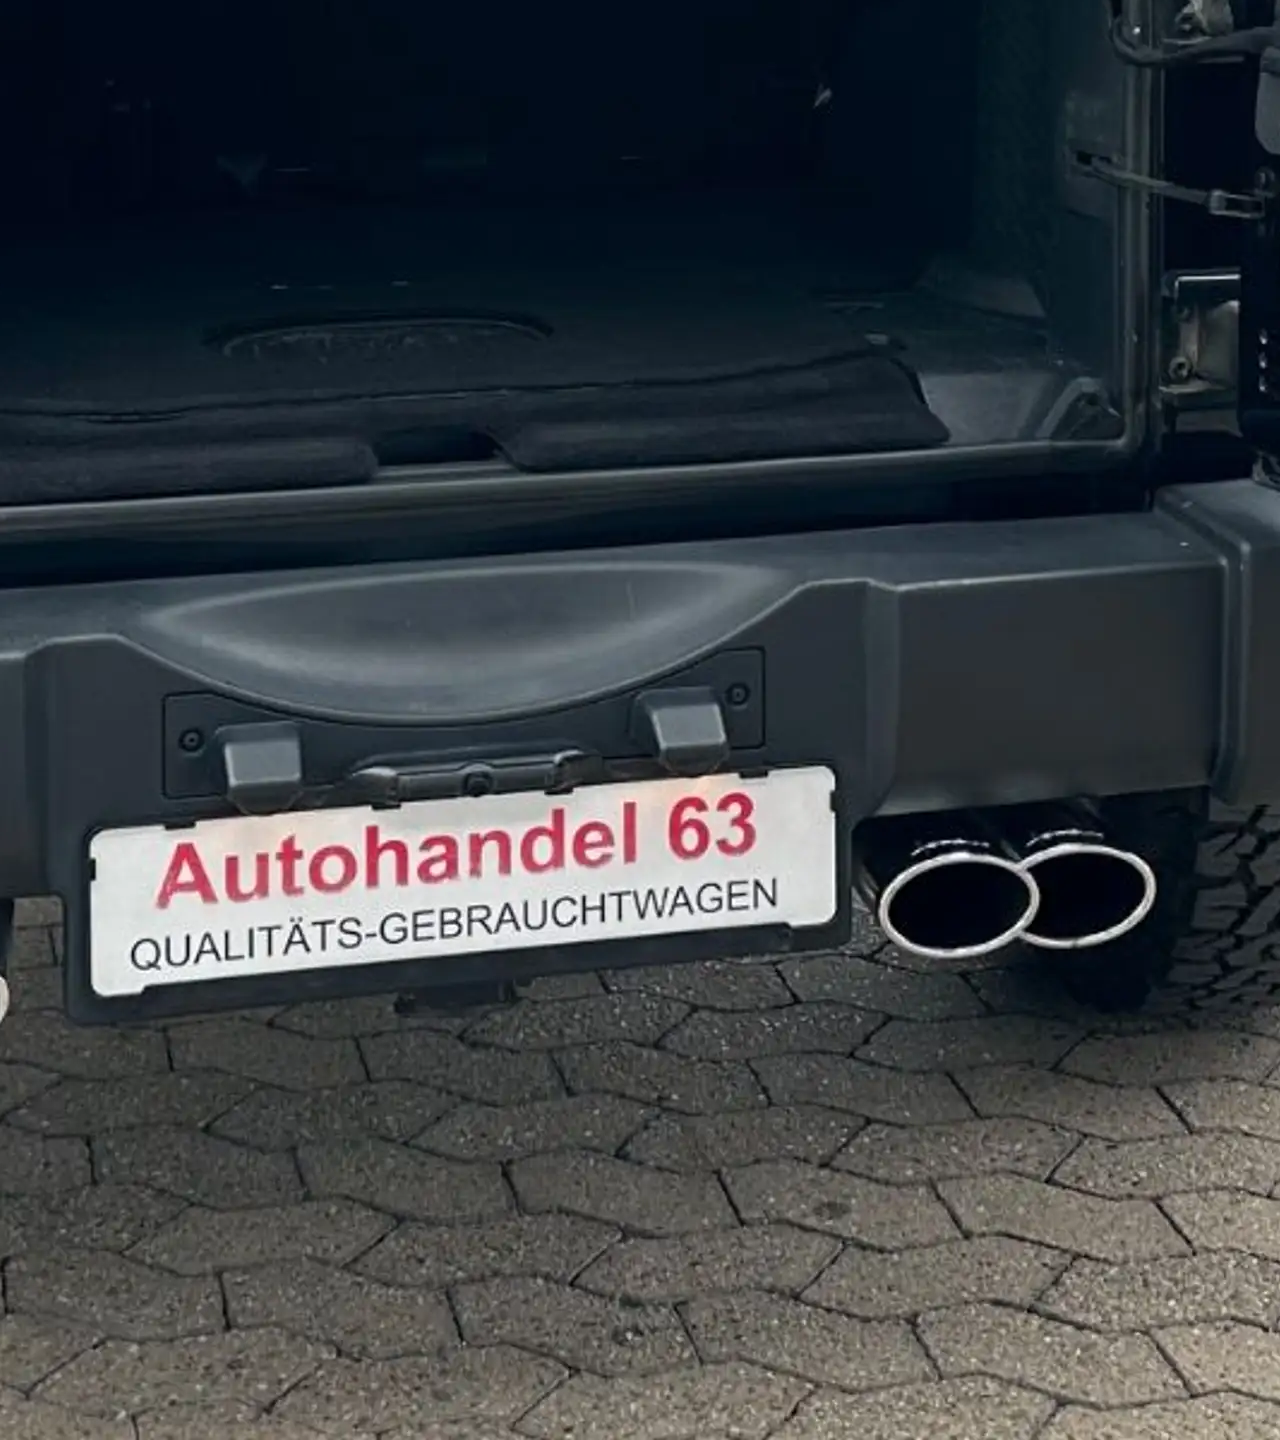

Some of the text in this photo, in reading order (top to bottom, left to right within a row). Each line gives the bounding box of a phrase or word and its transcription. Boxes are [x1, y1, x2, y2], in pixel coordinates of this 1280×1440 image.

[156, 790, 758, 909] Autohandel 63
[129, 877, 779, 973] QUALITÄTS-GEBRAUCHTWAGEN
